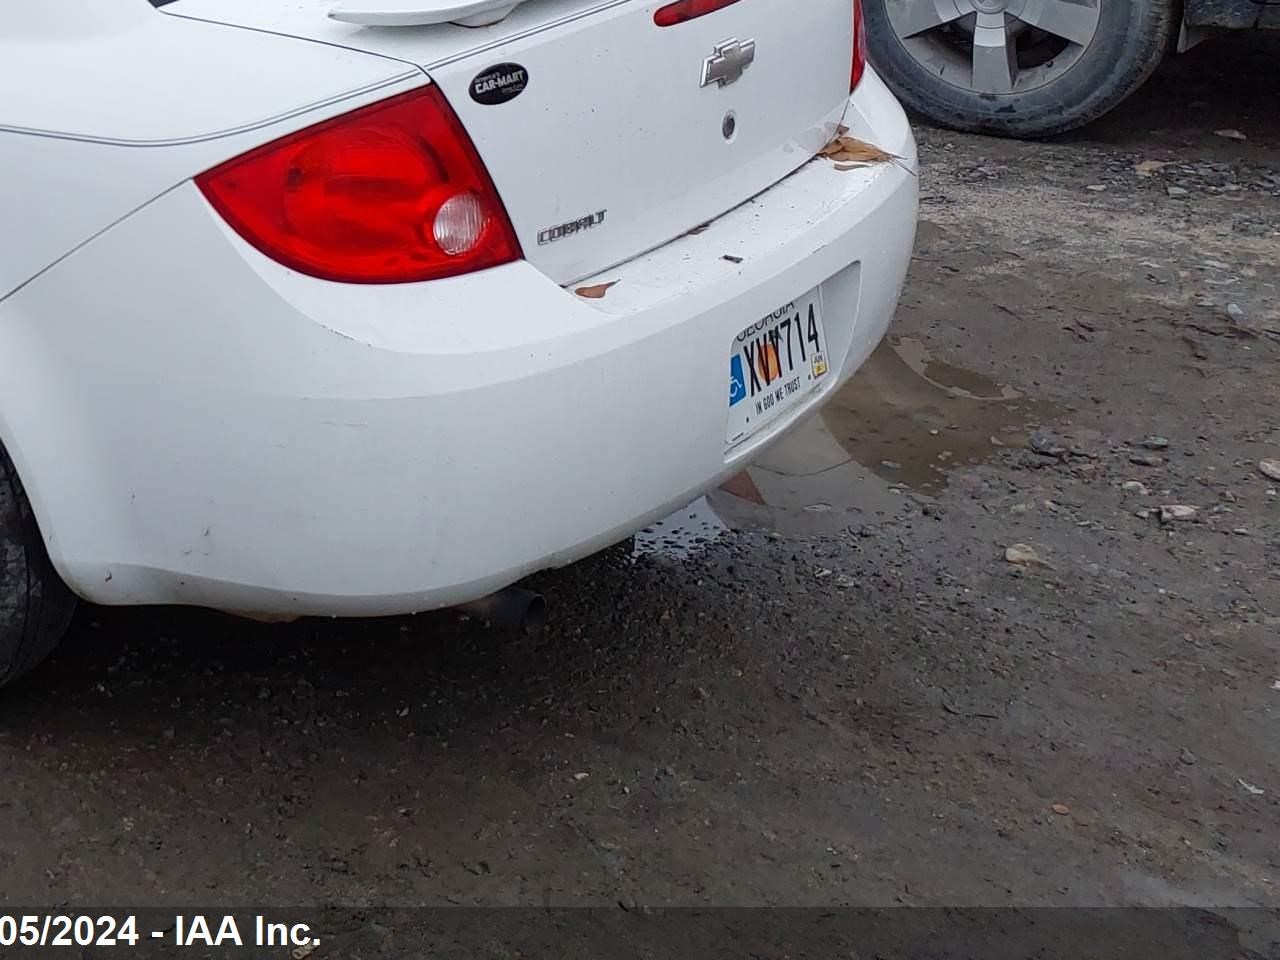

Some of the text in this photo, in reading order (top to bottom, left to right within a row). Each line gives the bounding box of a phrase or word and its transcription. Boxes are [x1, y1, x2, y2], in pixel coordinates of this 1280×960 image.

[475, 69, 524, 95] CAR-MART
[537, 209, 607, 246] COBALT
[755, 376, 801, 416] IN GOD WE TRUST
